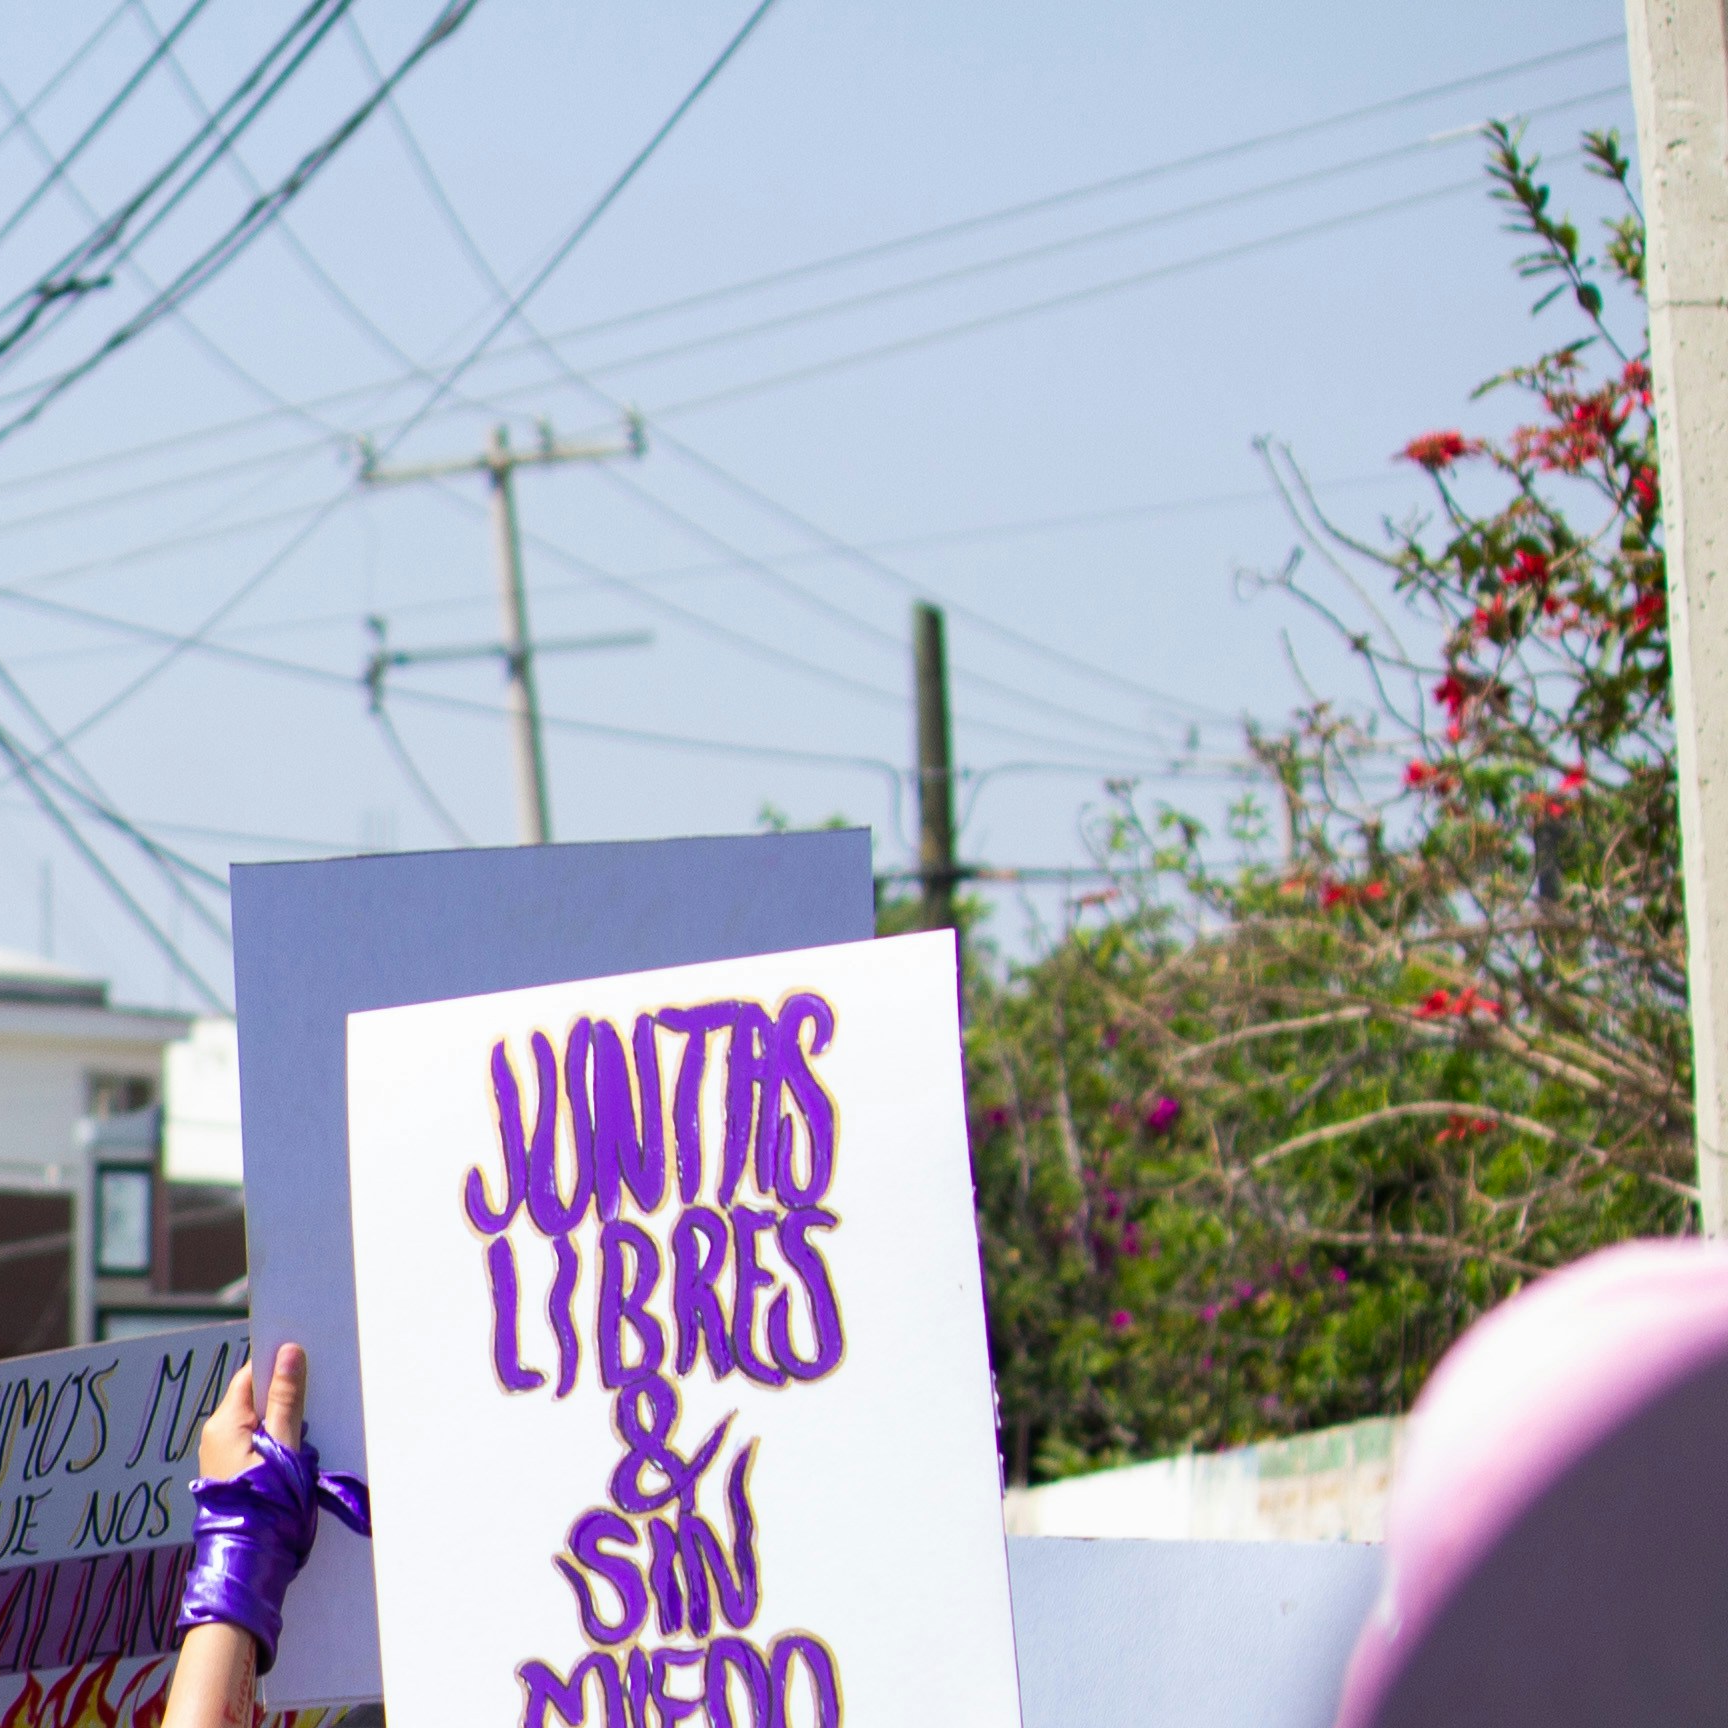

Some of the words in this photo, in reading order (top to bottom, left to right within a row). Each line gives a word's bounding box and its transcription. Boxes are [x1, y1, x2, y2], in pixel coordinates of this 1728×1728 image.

[462, 989, 840, 1236] JUNTAS
[486, 1206, 846, 1394] LIBRES
[124, 1336, 252, 1469] MA
[610, 1374, 740, 1514] &
[72, 1476, 173, 1549] NOS
[555, 1437, 761, 1646] SIN
